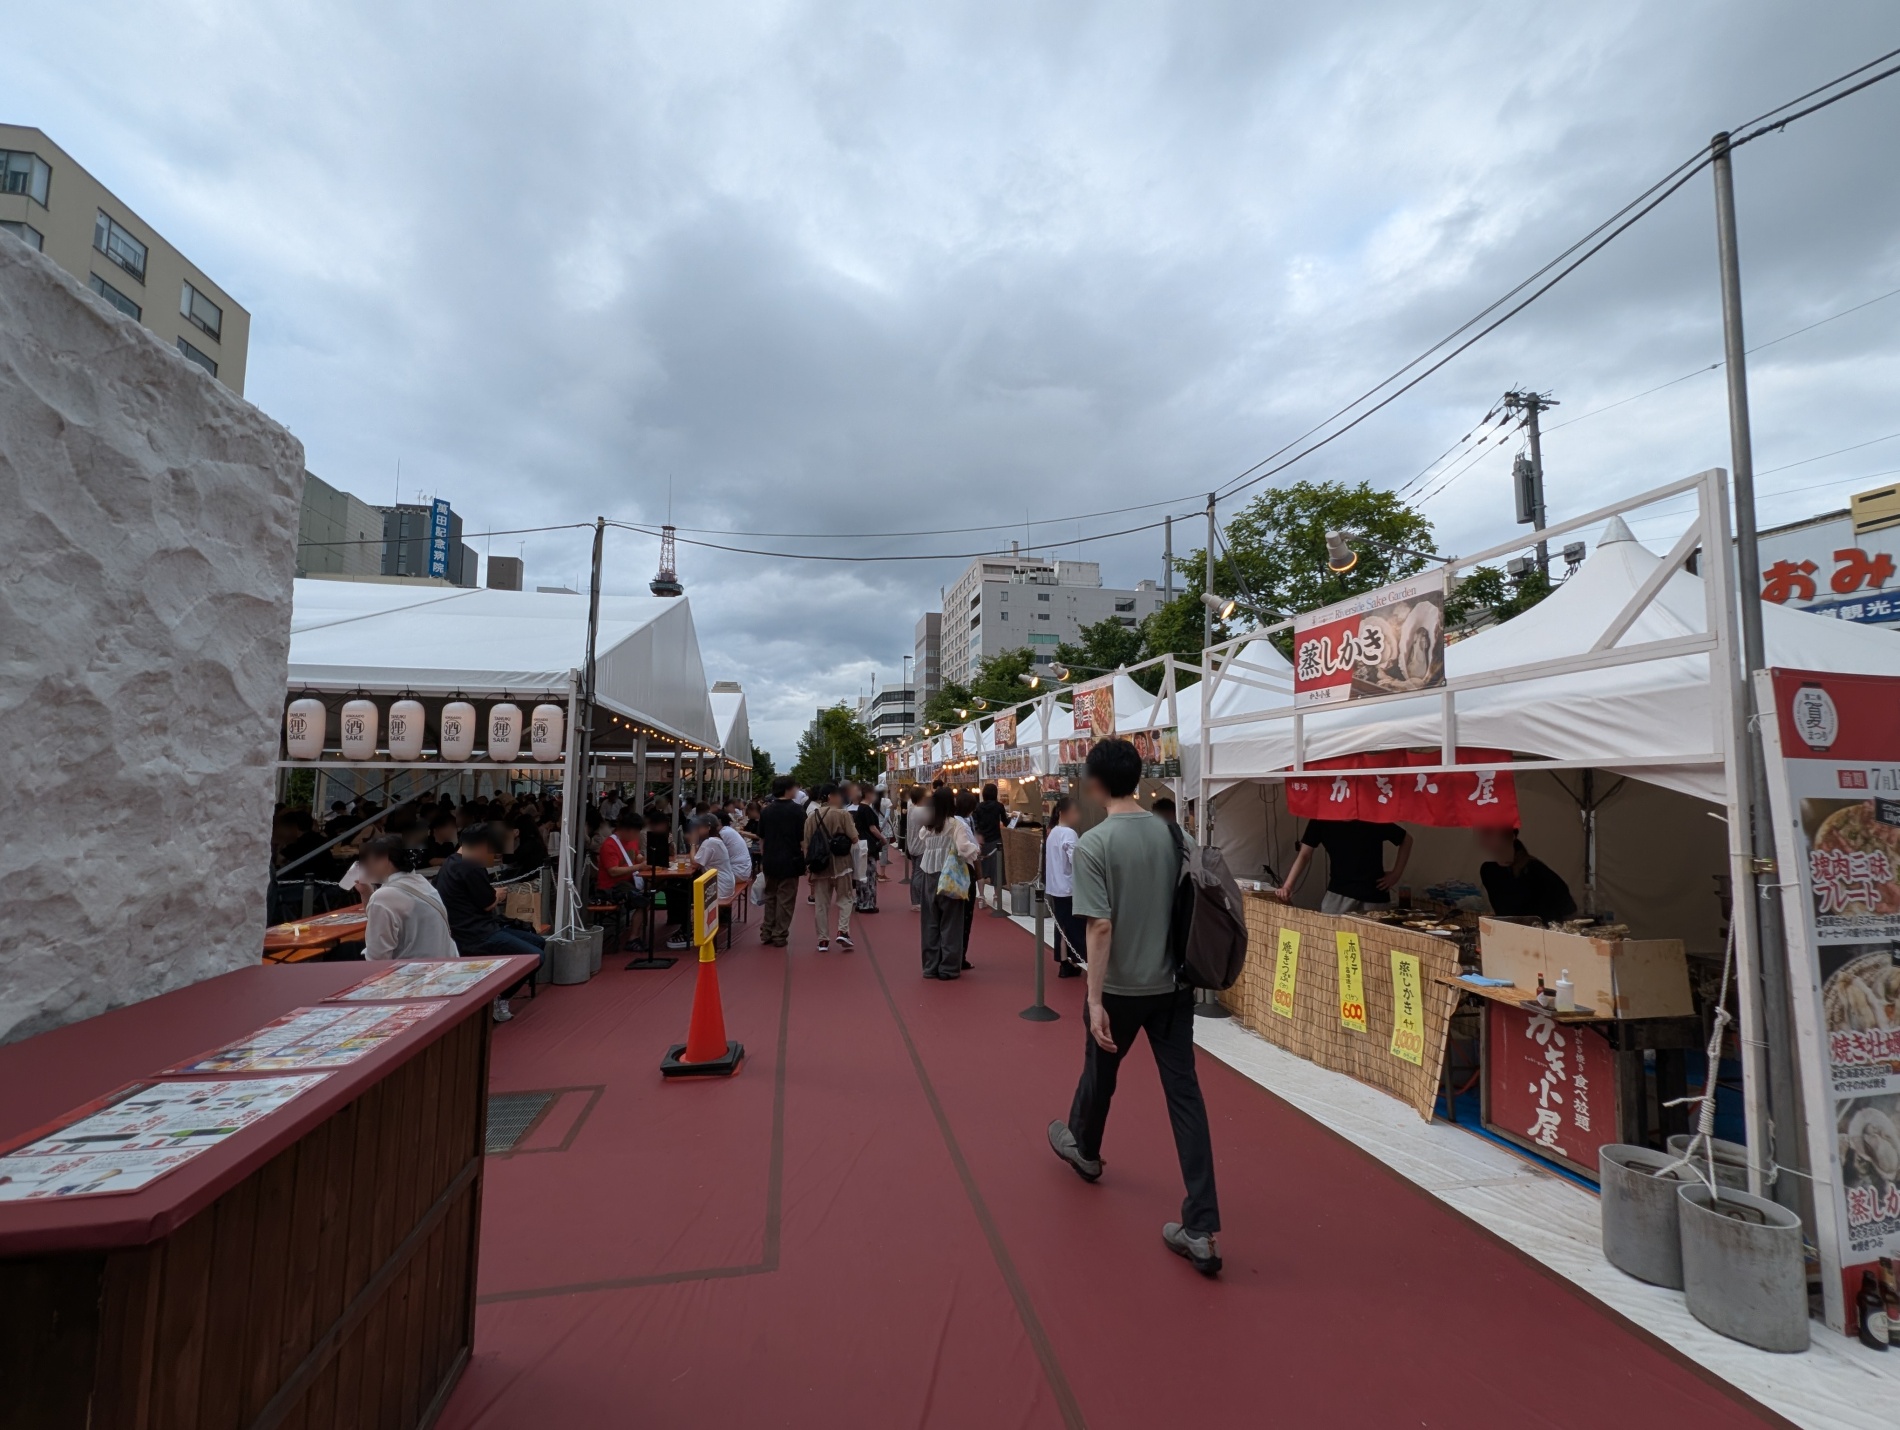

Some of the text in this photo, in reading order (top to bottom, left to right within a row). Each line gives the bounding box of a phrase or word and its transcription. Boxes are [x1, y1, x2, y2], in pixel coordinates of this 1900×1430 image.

[432, 502, 449, 573] 萬田記念病院
[1760, 547, 1898, 605] おみ
[1334, 602, 1366, 620] Riverside
[1366, 597, 1387, 611] Sake
[1388, 587, 1417, 602] Garden
[1298, 627, 1384, 681] 蒸しかき
[1309, 689, 1331, 700] かき小屋
[1807, 731, 1828, 742] まつり
[1871, 768, 1900, 791] 7月1
[1812, 852, 1891, 882] 塊肉三昧
[1814, 882, 1880, 911] プレート
[1348, 939, 1359, 975] ホタテ
[1274, 989, 1292, 1008] 600
[1398, 960, 1415, 1016] 蒸しかき
[1342, 1002, 1363, 1020] 600
[1525, 1013, 1568, 1157] かき小屋
[1572, 1073, 1591, 1132] 食べ放題
